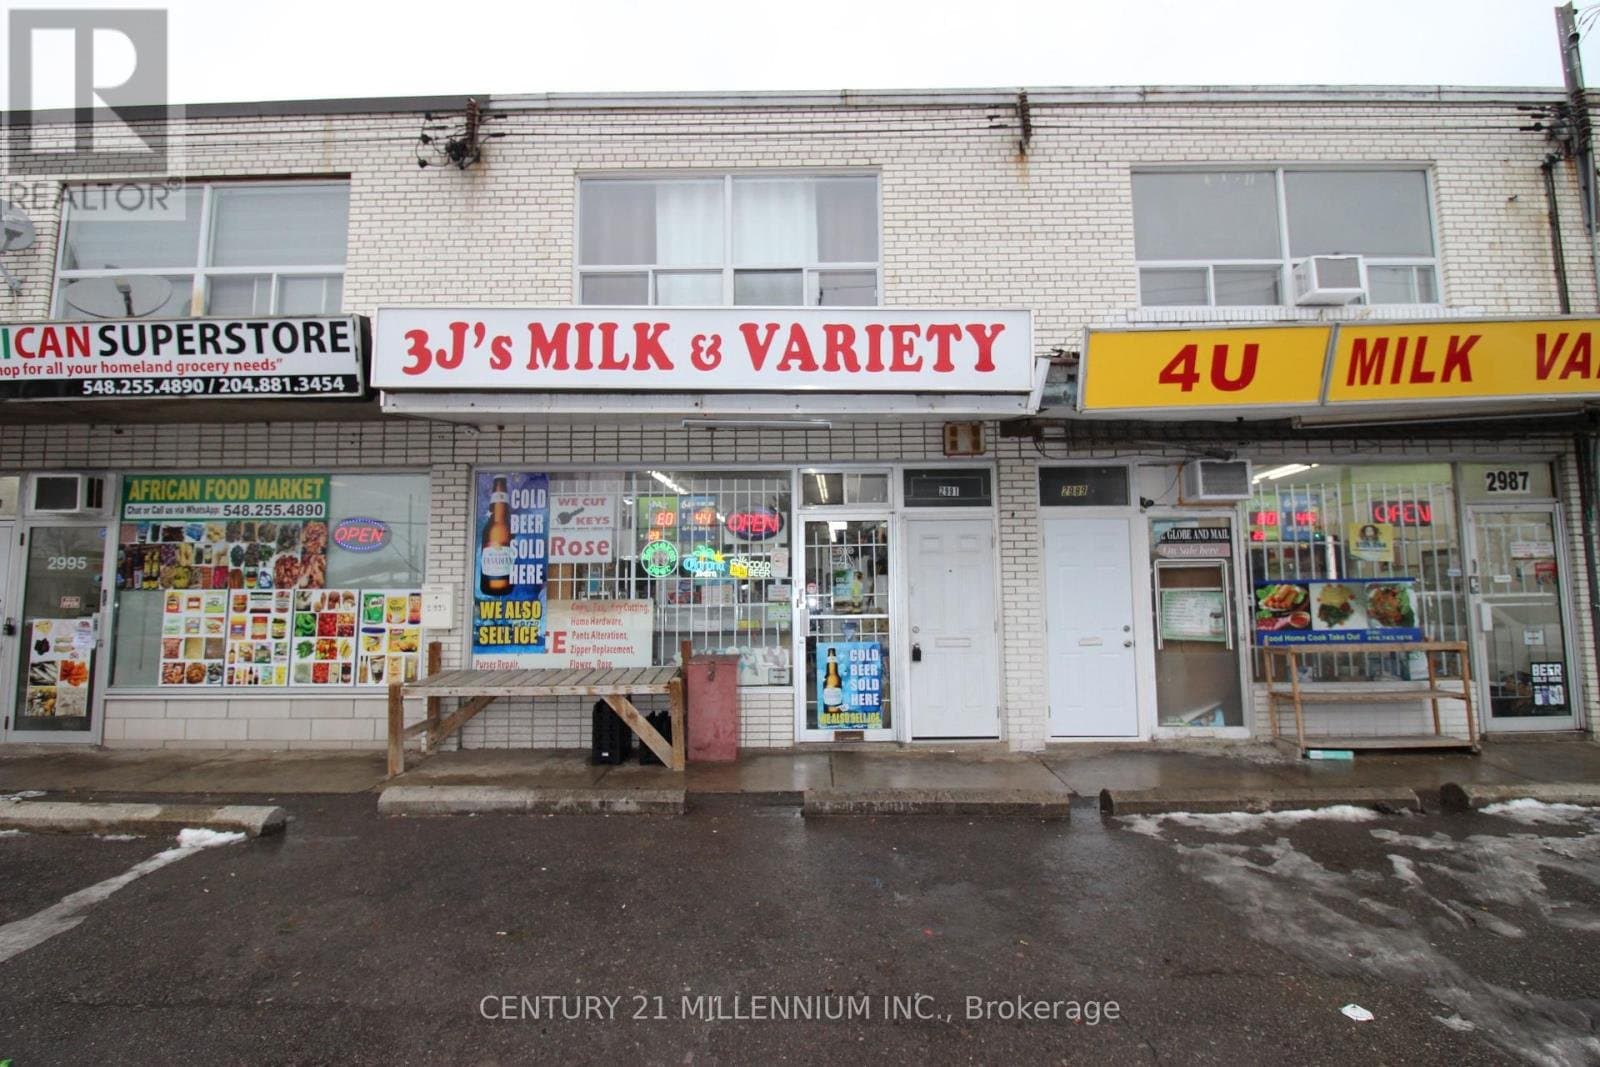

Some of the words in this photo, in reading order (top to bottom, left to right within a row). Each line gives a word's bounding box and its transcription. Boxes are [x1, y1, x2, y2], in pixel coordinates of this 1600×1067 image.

[98, 321, 350, 357] SUPERSTORE
[402, 322, 512, 375] 3J's
[526, 322, 674, 371] MILK
[691, 334, 722, 371] &
[739, 322, 1005, 372] VARIETY
[23, 362, 42, 375] for
[47, 362, 63, 375] all
[67, 364, 97, 377] your
[101, 360, 172, 374] homeland
[176, 362, 229, 376] grocery
[1158, 344, 1259, 392] 4U
[1346, 335, 1482, 386] MILK
[1536, 332, 1600, 380] VA
[83, 379, 204, 394] 548.255.4890
[208, 379, 215, 393] /
[219, 377, 345, 392] 204.881.3454
[128, 479, 200, 500] AFRICAN
[205, 478, 250, 500] FOOD
[255, 478, 324, 499] MARKET
[1486, 471, 1529, 491] 2987
[511, 488, 546, 509] COLD
[558, 497, 578, 506] WE
[582, 497, 607, 506] CUT
[223, 504, 323, 517] 548.255.4890
[1374, 503, 1431, 523] OPEN
[510, 514, 544, 534] BEER
[576, 516, 609, 526] KEYS
[727, 512, 780, 533] OPEN
[334, 527, 384, 544] OPEN
[1166, 528, 1193, 540] GLOBE
[1194, 528, 1210, 540] AND
[1210, 528, 1230, 540] MAIL
[510, 539, 545, 559] SOLD
[550, 536, 610, 556] Rose
[47, 557, 87, 570] 2995
[749, 560, 771, 570] COLD
[509, 564, 543, 584] HERE
[748, 569, 771, 577] BEER
[480, 602, 503, 619] WE
[505, 601, 542, 619] ALSO
[479, 627, 511, 645] SELL
[514, 627, 538, 645] ICE
[850, 649, 879, 662] COLD
[851, 664, 878, 676] BEER
[1532, 663, 1562, 676] BEER
[850, 678, 880, 691] SOLD
[851, 693, 880, 706] HERE
